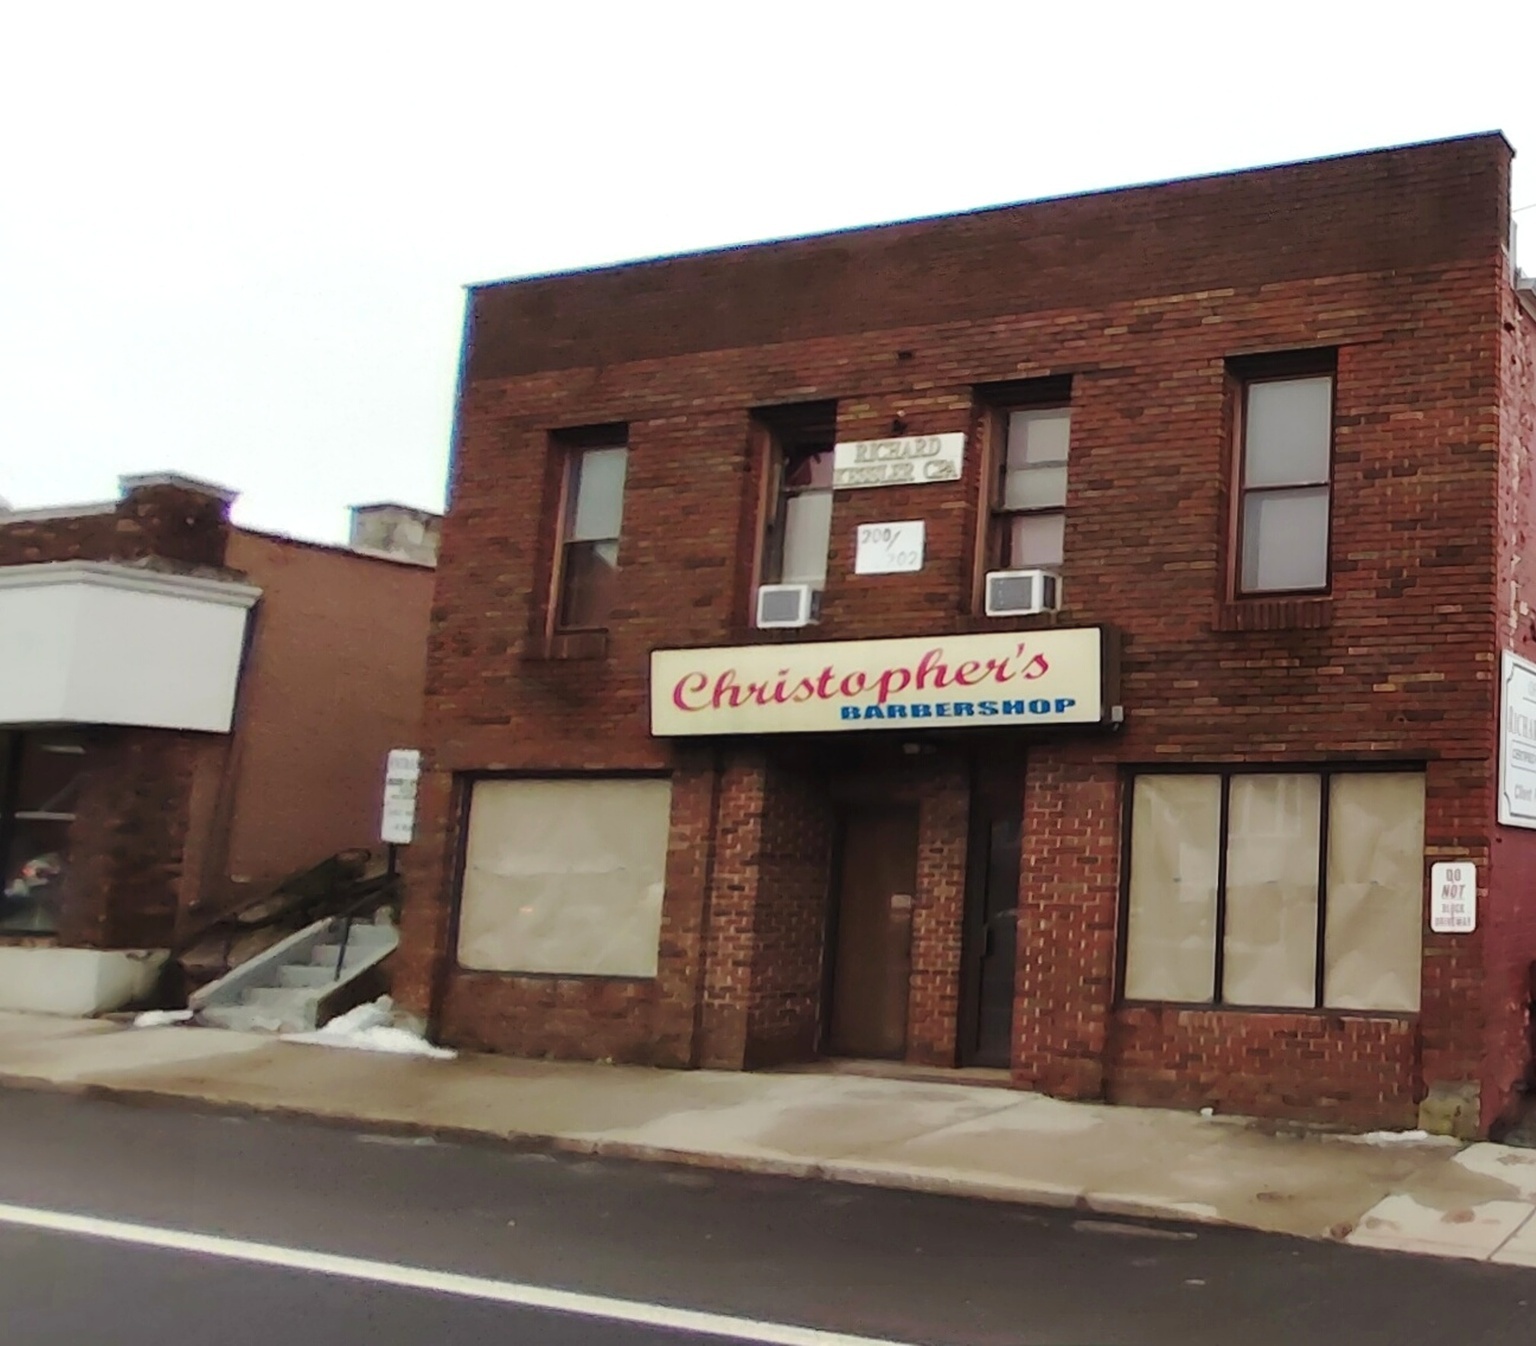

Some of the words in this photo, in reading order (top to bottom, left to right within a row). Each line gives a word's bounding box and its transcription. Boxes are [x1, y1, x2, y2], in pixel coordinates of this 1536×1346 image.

[854, 436, 942, 463] RICHARD
[923, 459, 959, 479] CPA
[672, 642, 1051, 715] Christopher's
[840, 697, 1077, 722] BARBERSHOP
[1514, 783, 1532, 802] Client
[1445, 868, 1461, 882] DO
[1441, 884, 1465, 899] NOT
[1441, 903, 1465, 913] BLOCK
